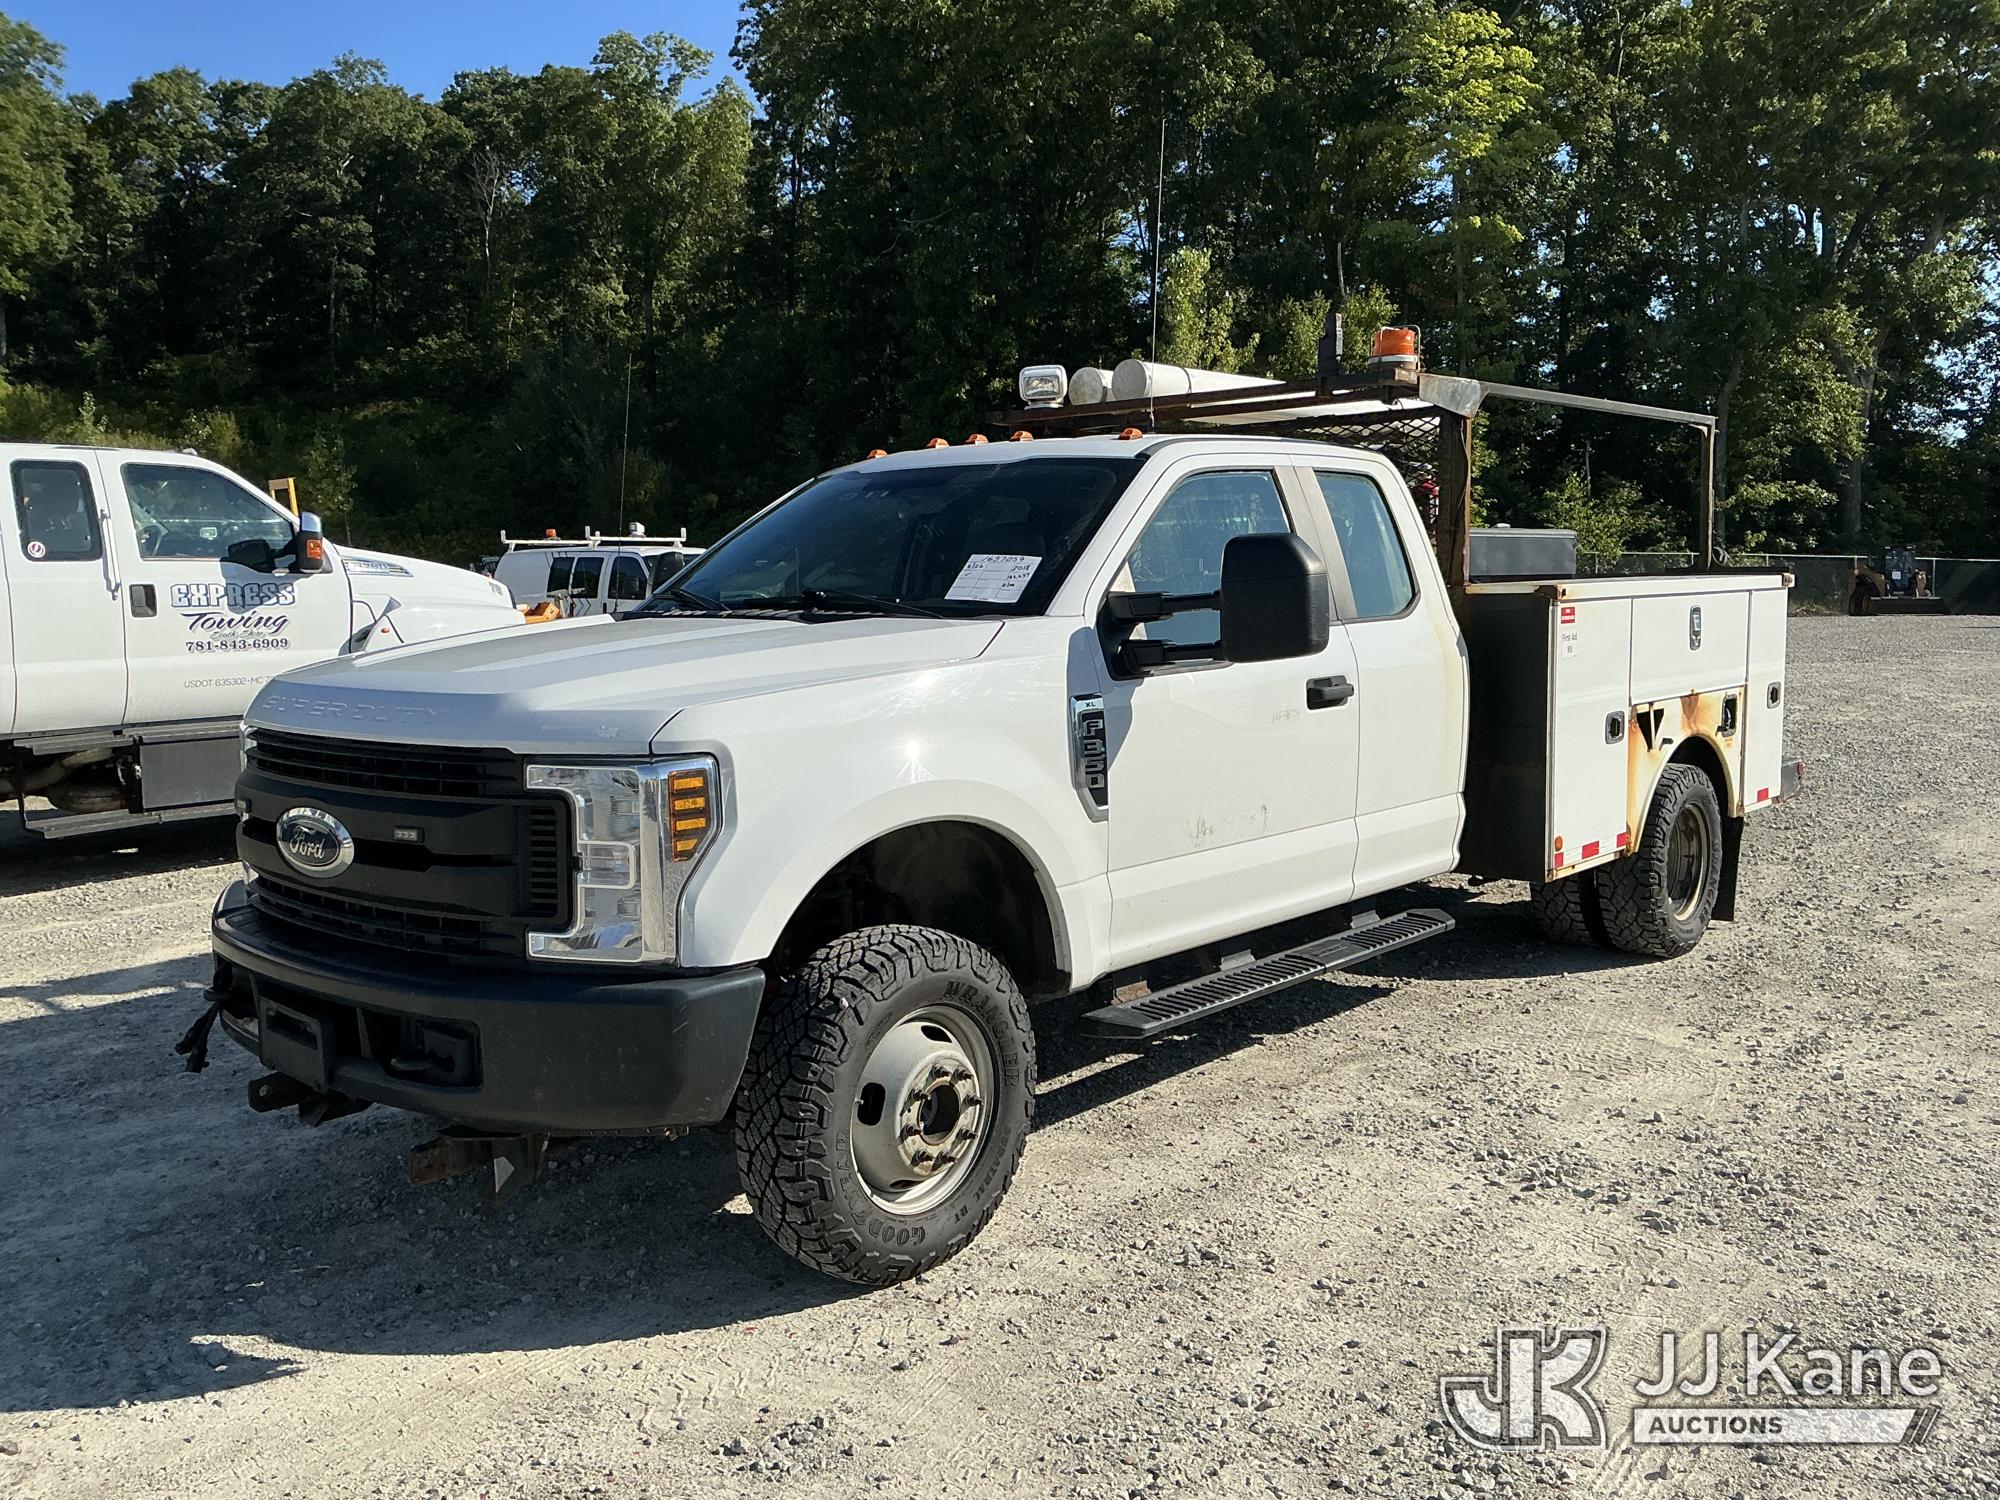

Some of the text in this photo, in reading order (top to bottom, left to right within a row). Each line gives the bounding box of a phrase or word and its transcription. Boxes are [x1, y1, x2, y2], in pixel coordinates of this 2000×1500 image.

[170, 582, 296, 608] EXPRESS
[179, 610, 289, 635] Towing
[185, 638, 288, 652] 781-843-6909
[184, 679, 213, 689] USDOT
[1083, 718, 1106, 789] F350
[289, 825, 326, 860] Ford
[943, 979, 1020, 1087] WRANGLER
